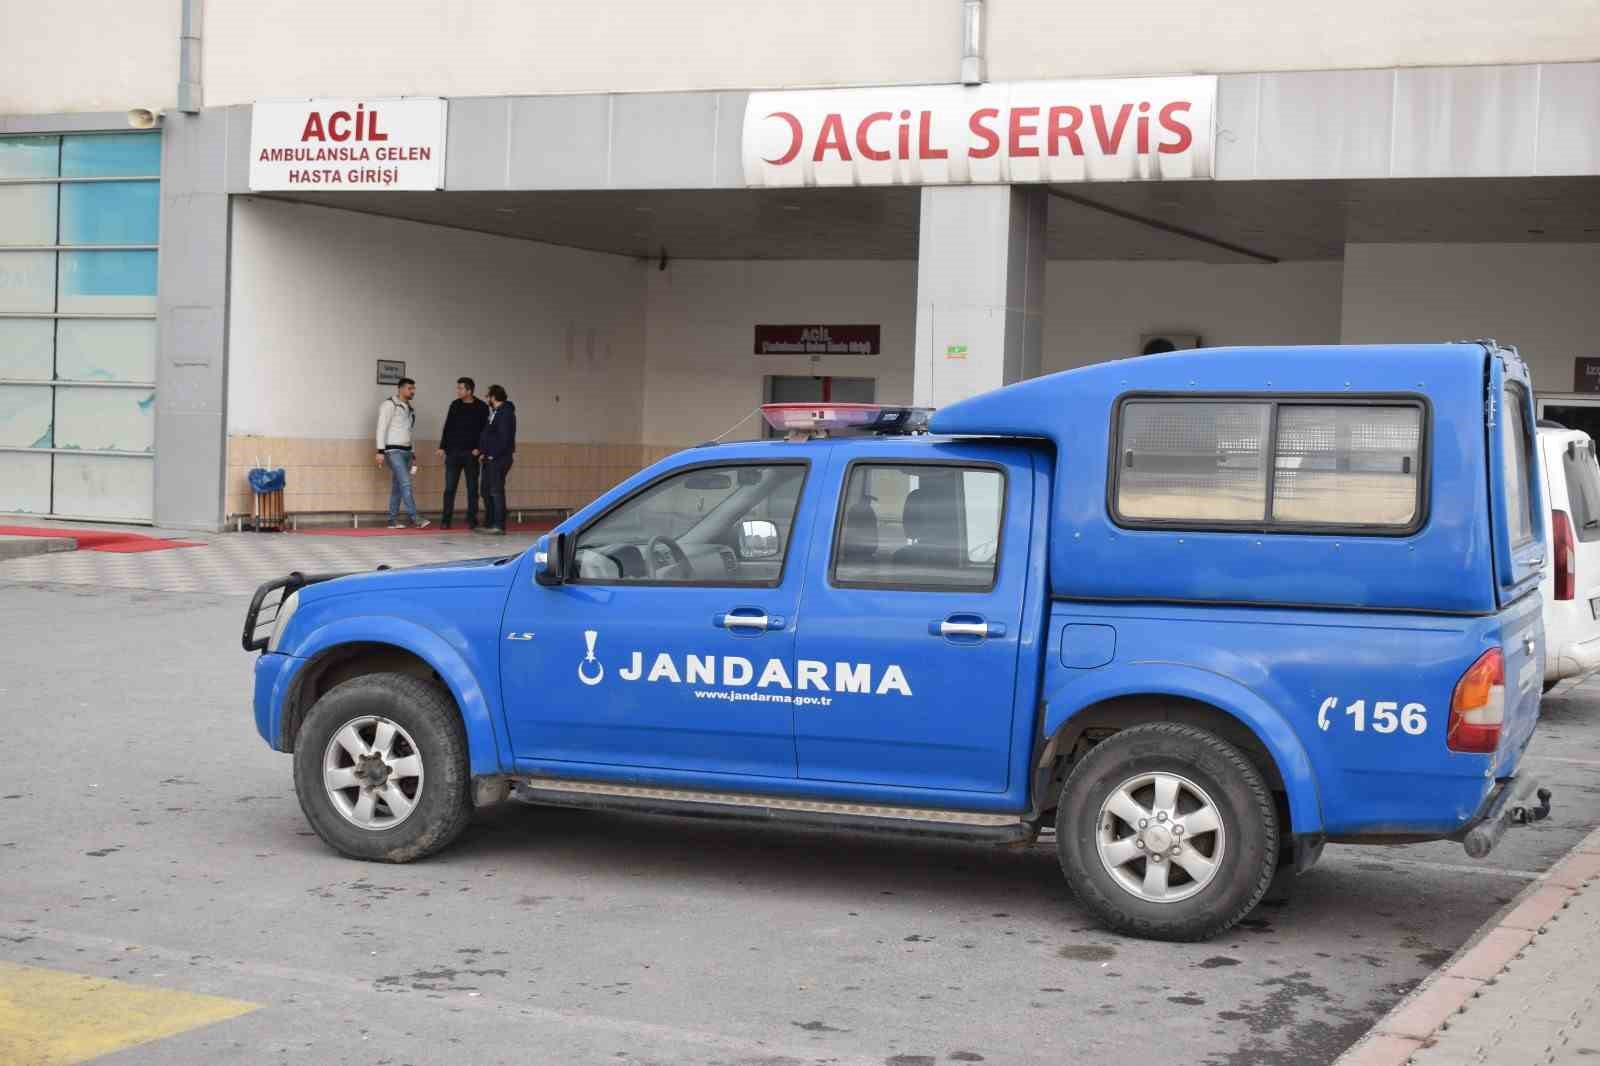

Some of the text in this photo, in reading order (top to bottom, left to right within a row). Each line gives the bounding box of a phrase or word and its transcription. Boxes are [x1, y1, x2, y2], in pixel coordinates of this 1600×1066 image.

[301, 102, 388, 142] ACİL
[259, 147, 431, 162] AMBULANSLA GELEN
[289, 166, 398, 186] HASTA GİRİŞİ
[619, 651, 913, 696] JANDARMA
[694, 690, 833, 706] www.jandarma.gov.tr
[1345, 700, 1428, 735] 156
